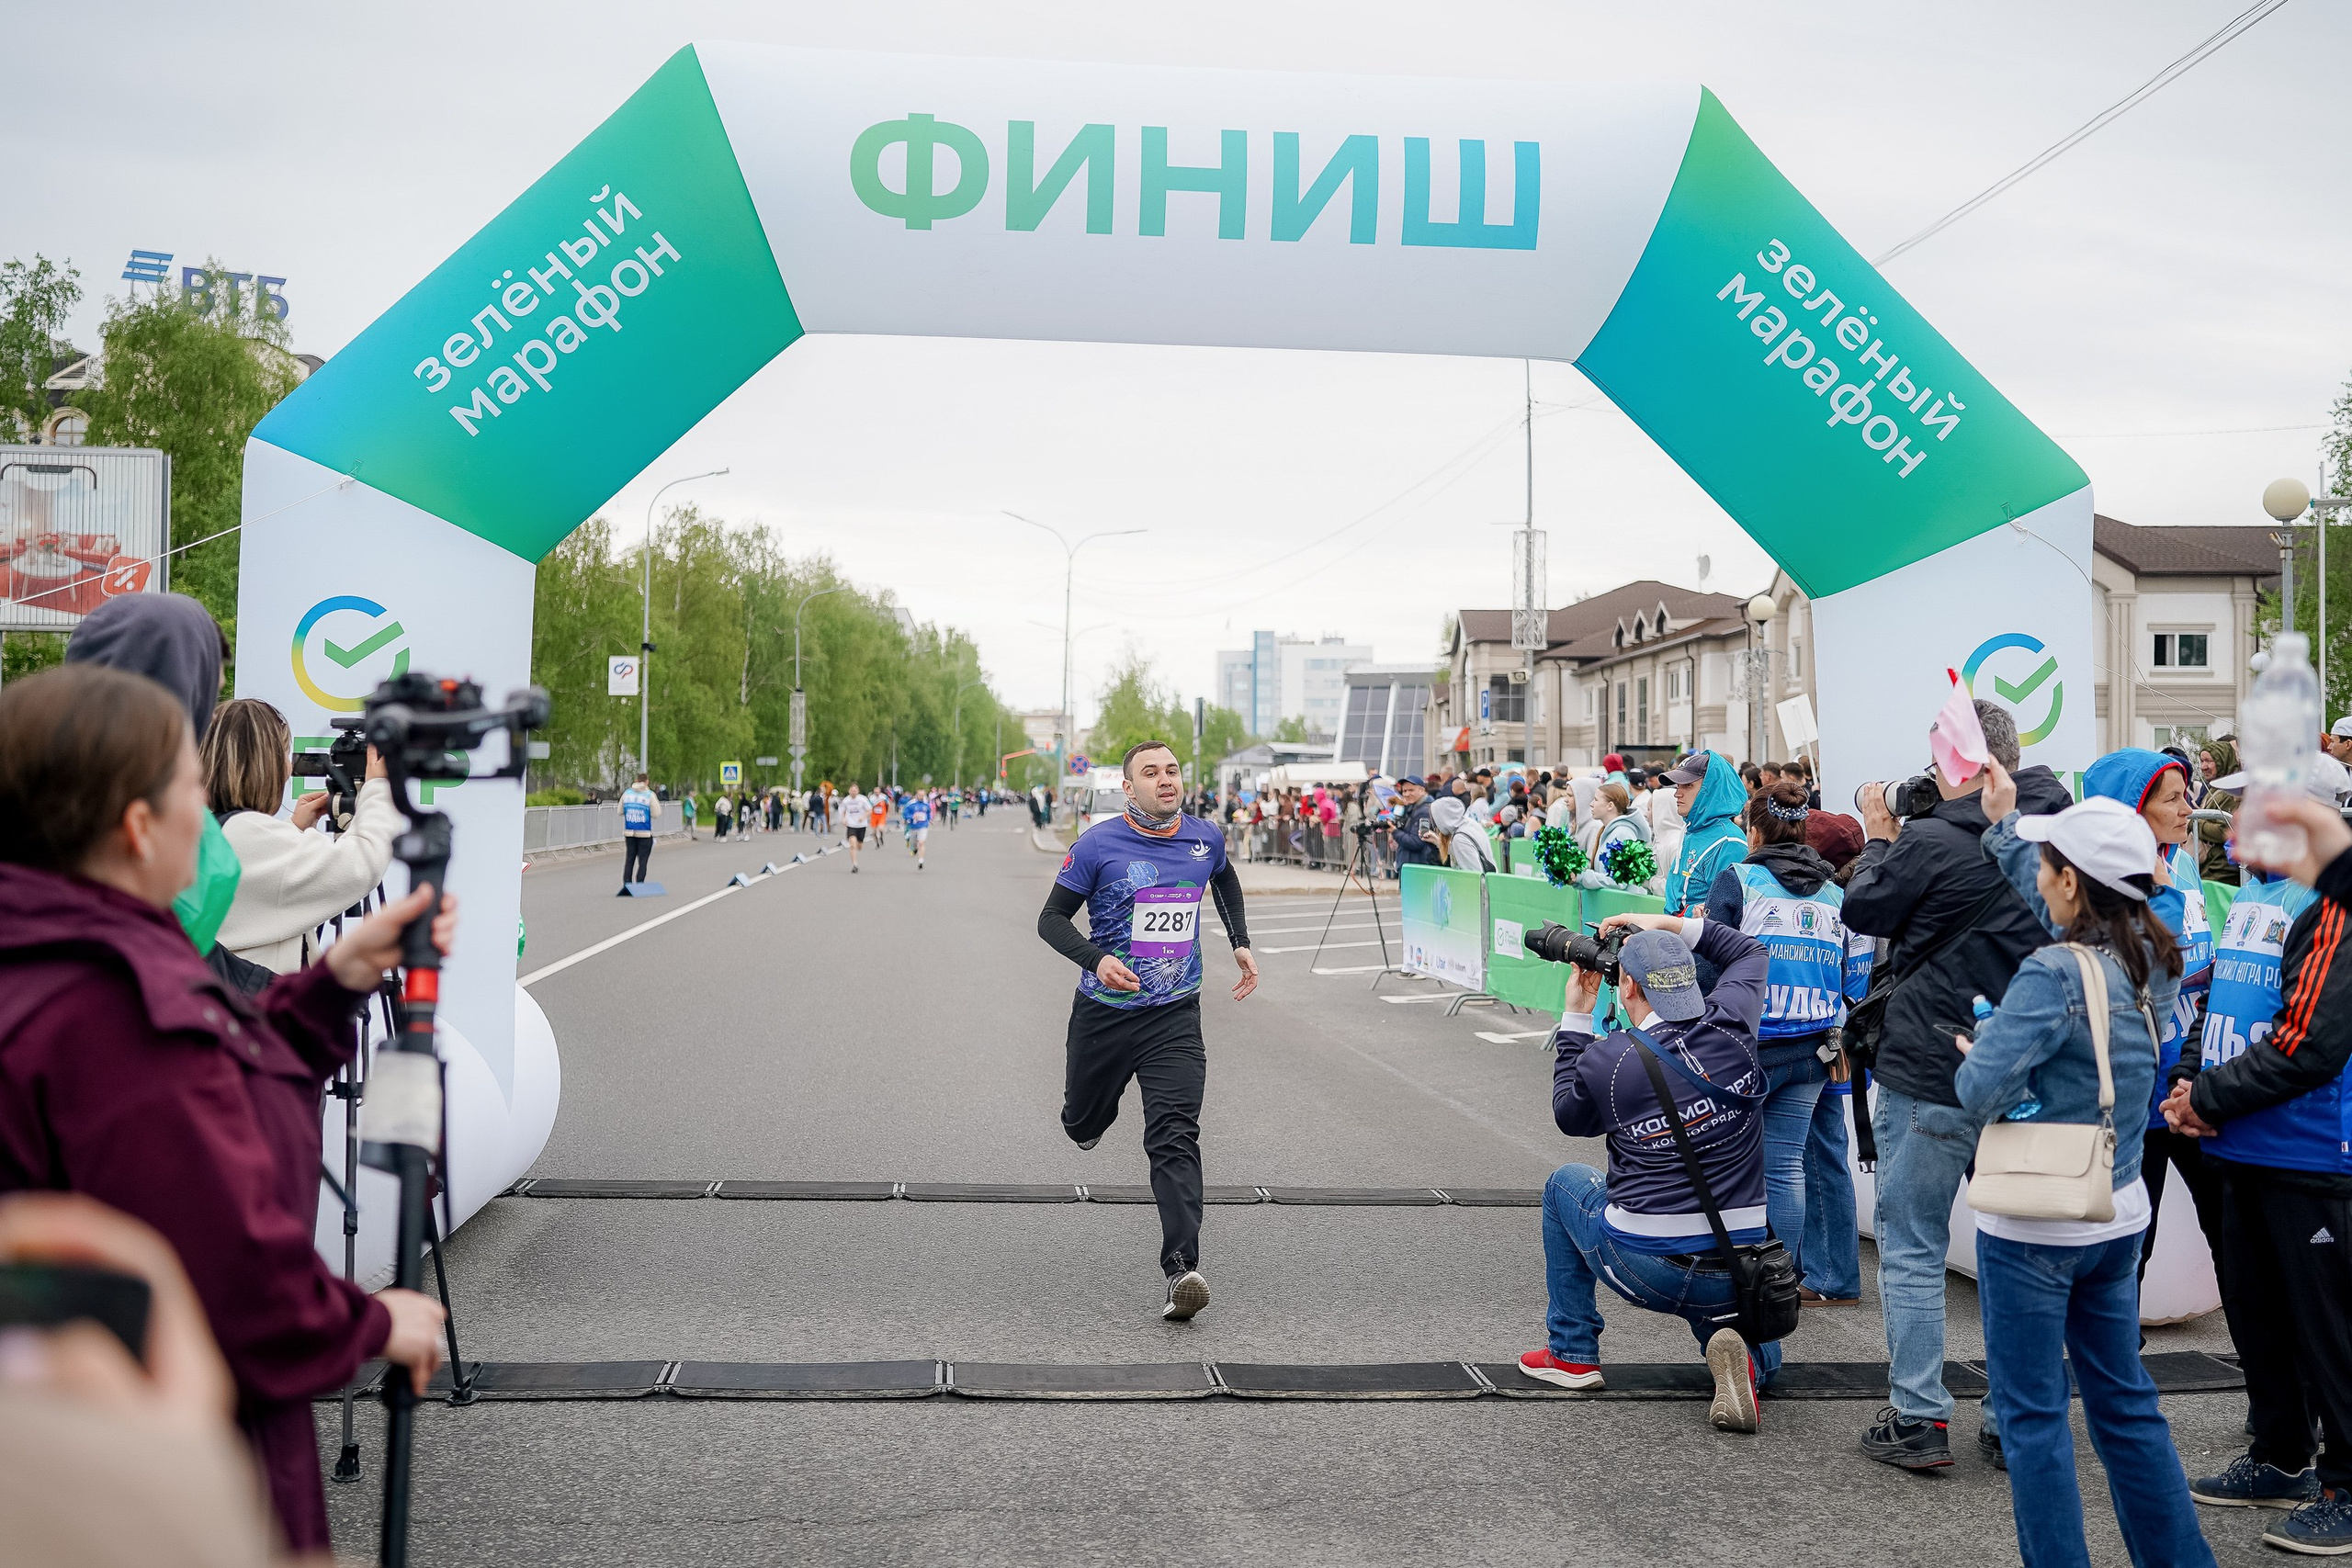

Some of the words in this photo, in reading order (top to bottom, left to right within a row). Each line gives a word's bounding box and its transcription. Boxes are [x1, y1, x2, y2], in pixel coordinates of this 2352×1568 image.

[850, 113, 1540, 251] ФИНИШ
[182, 266, 288, 321] ВТБ
[413, 184, 643, 393] зелёный
[448, 231, 682, 437] марафон
[1756, 238, 1966, 442] зелёный
[1715, 272, 1928, 479] марафон
[1144, 911, 1193, 932] 2287
[1652, 1122, 1710, 1149] КОСОС
